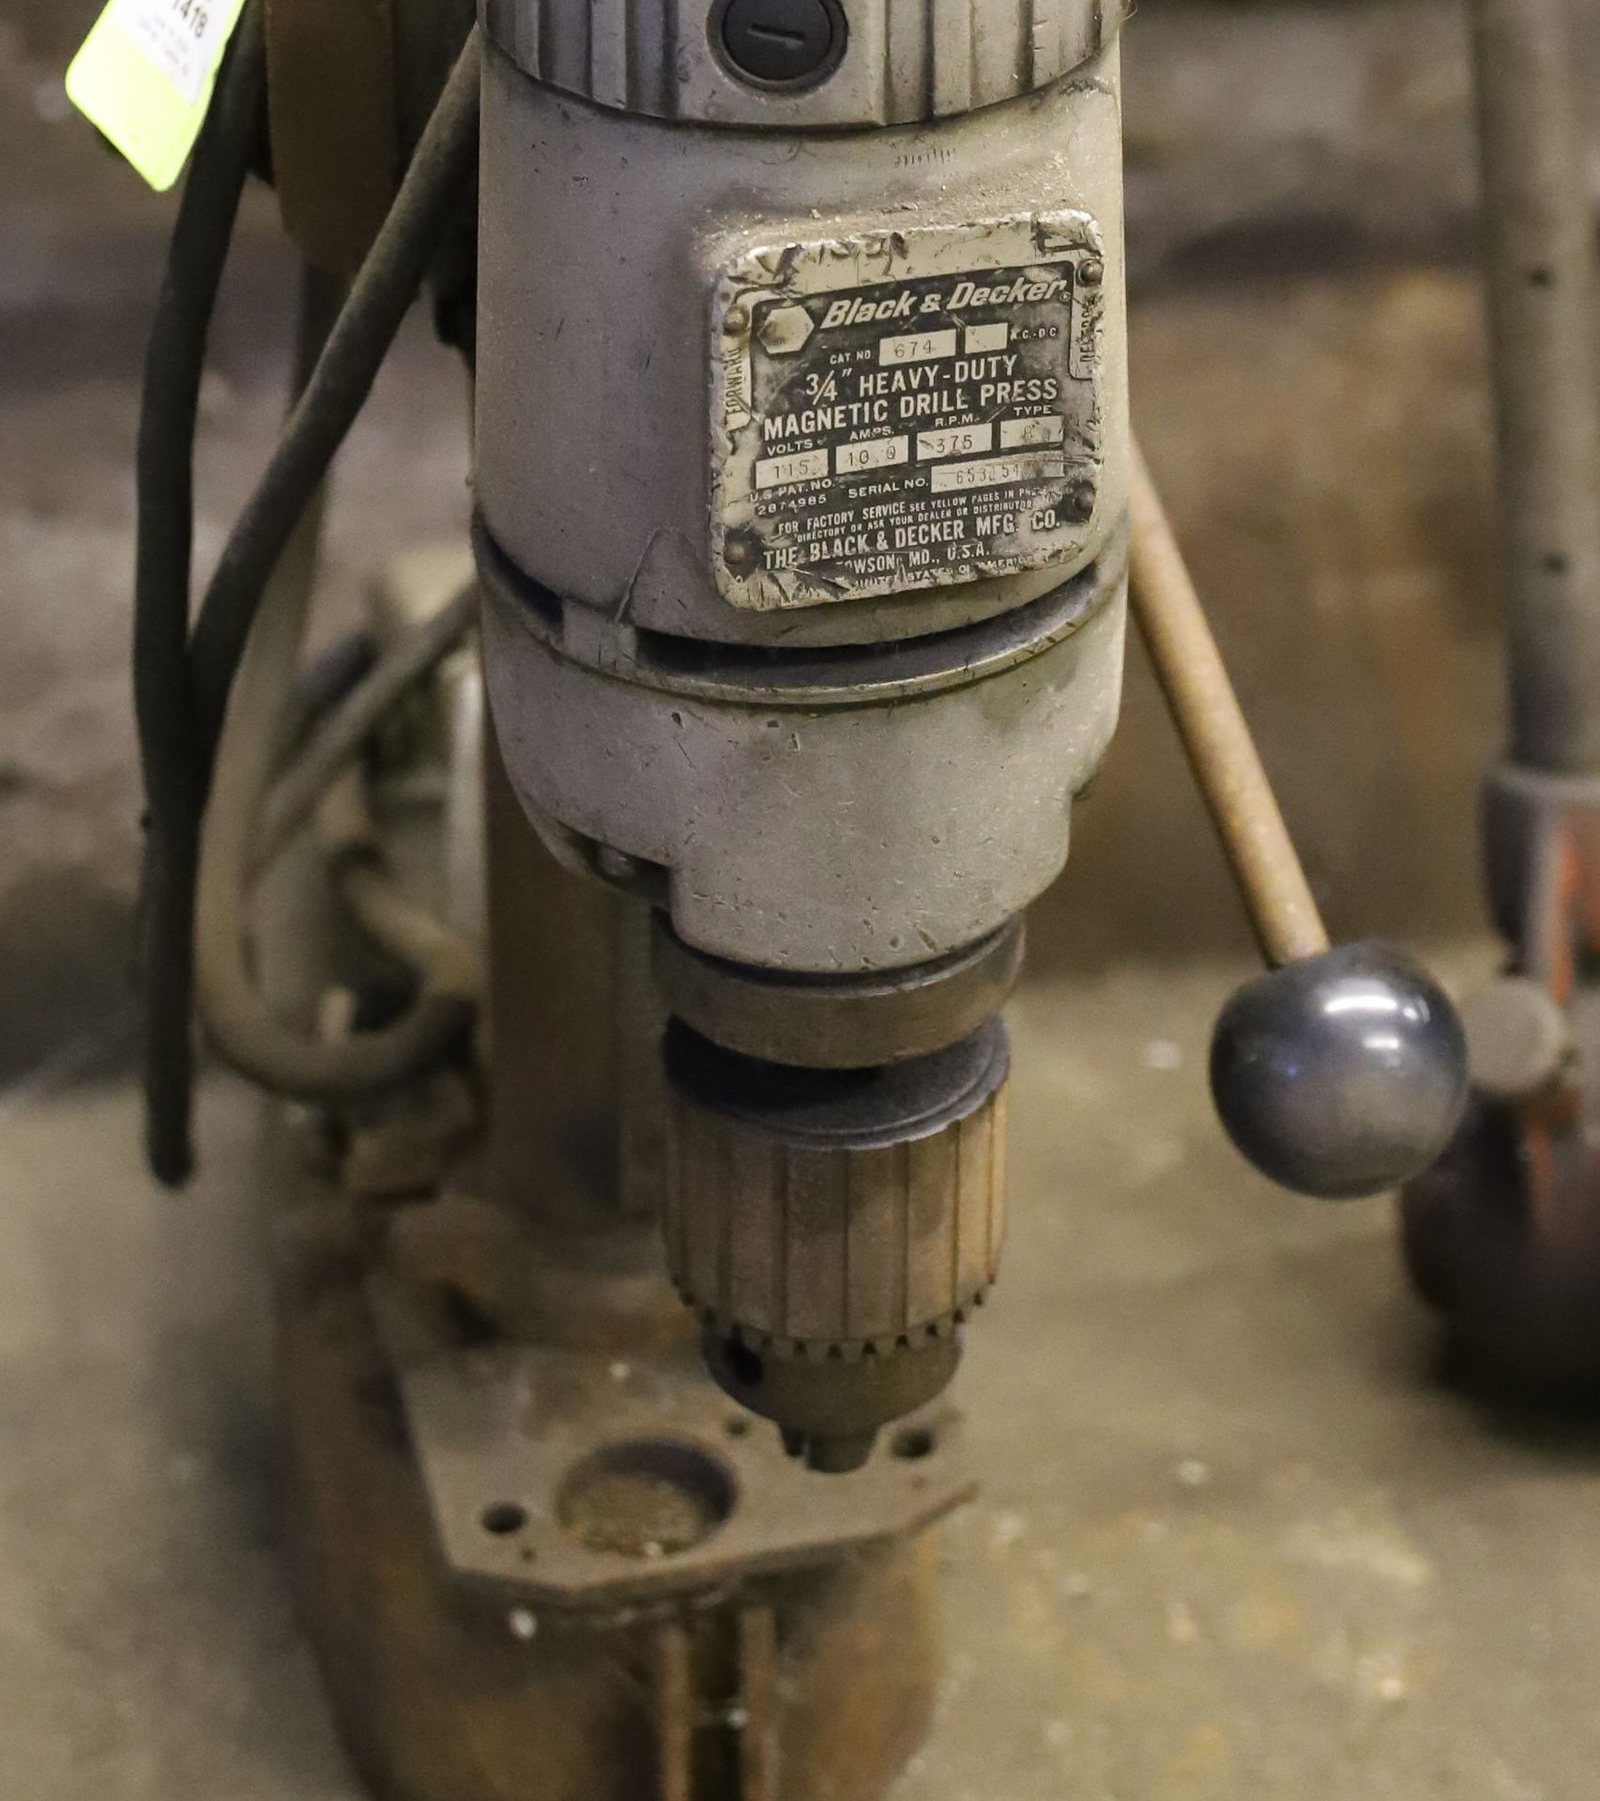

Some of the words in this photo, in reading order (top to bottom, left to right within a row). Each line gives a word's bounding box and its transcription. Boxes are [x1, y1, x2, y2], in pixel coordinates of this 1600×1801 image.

[820, 290, 917, 329] Black
[920, 293, 941, 314] &
[946, 277, 1067, 311] Decker
[894, 340, 932, 358] 674
[859, 355, 1018, 397] HEAVY-DUTY
[763, 399, 889, 441] MAGNETIC
[900, 389, 968, 418] DRILL
[980, 379, 1058, 407] PRESS
[1014, 405, 1052, 416] TYPE
[766, 438, 813, 456] VOLTS
[936, 434, 973, 453] 375
[774, 460, 808, 479] 115
[848, 484, 900, 498] SERIAL
[904, 477, 929, 489] NO.
[778, 521, 799, 536] FOR
[807, 510, 854, 531] FACTORY
[862, 501, 905, 520] SERVICE
[910, 502, 926, 512] SEE
[931, 496, 967, 509] YELLOW
[971, 491, 1000, 505] PAGES
[1004, 488, 1014, 499] IN
[797, 528, 846, 543] DIRECTORY
[851, 523, 862, 533] OR
[867, 519, 884, 530] ASK
[890, 515, 913, 526] YOUR
[918, 508, 951, 521] DEALER
[956, 506, 968, 516] OR
[973, 500, 1033, 515] DISTRIBUTOR
[763, 547, 798, 570] THE
[809, 533, 869, 562] BLACK
[876, 530, 889, 550] &
[895, 520, 965, 548] DECKER
[976, 514, 1019, 537] MFG.
[1032, 509, 1060, 531] CO.
[947, 542, 989, 561] U.S.A.
